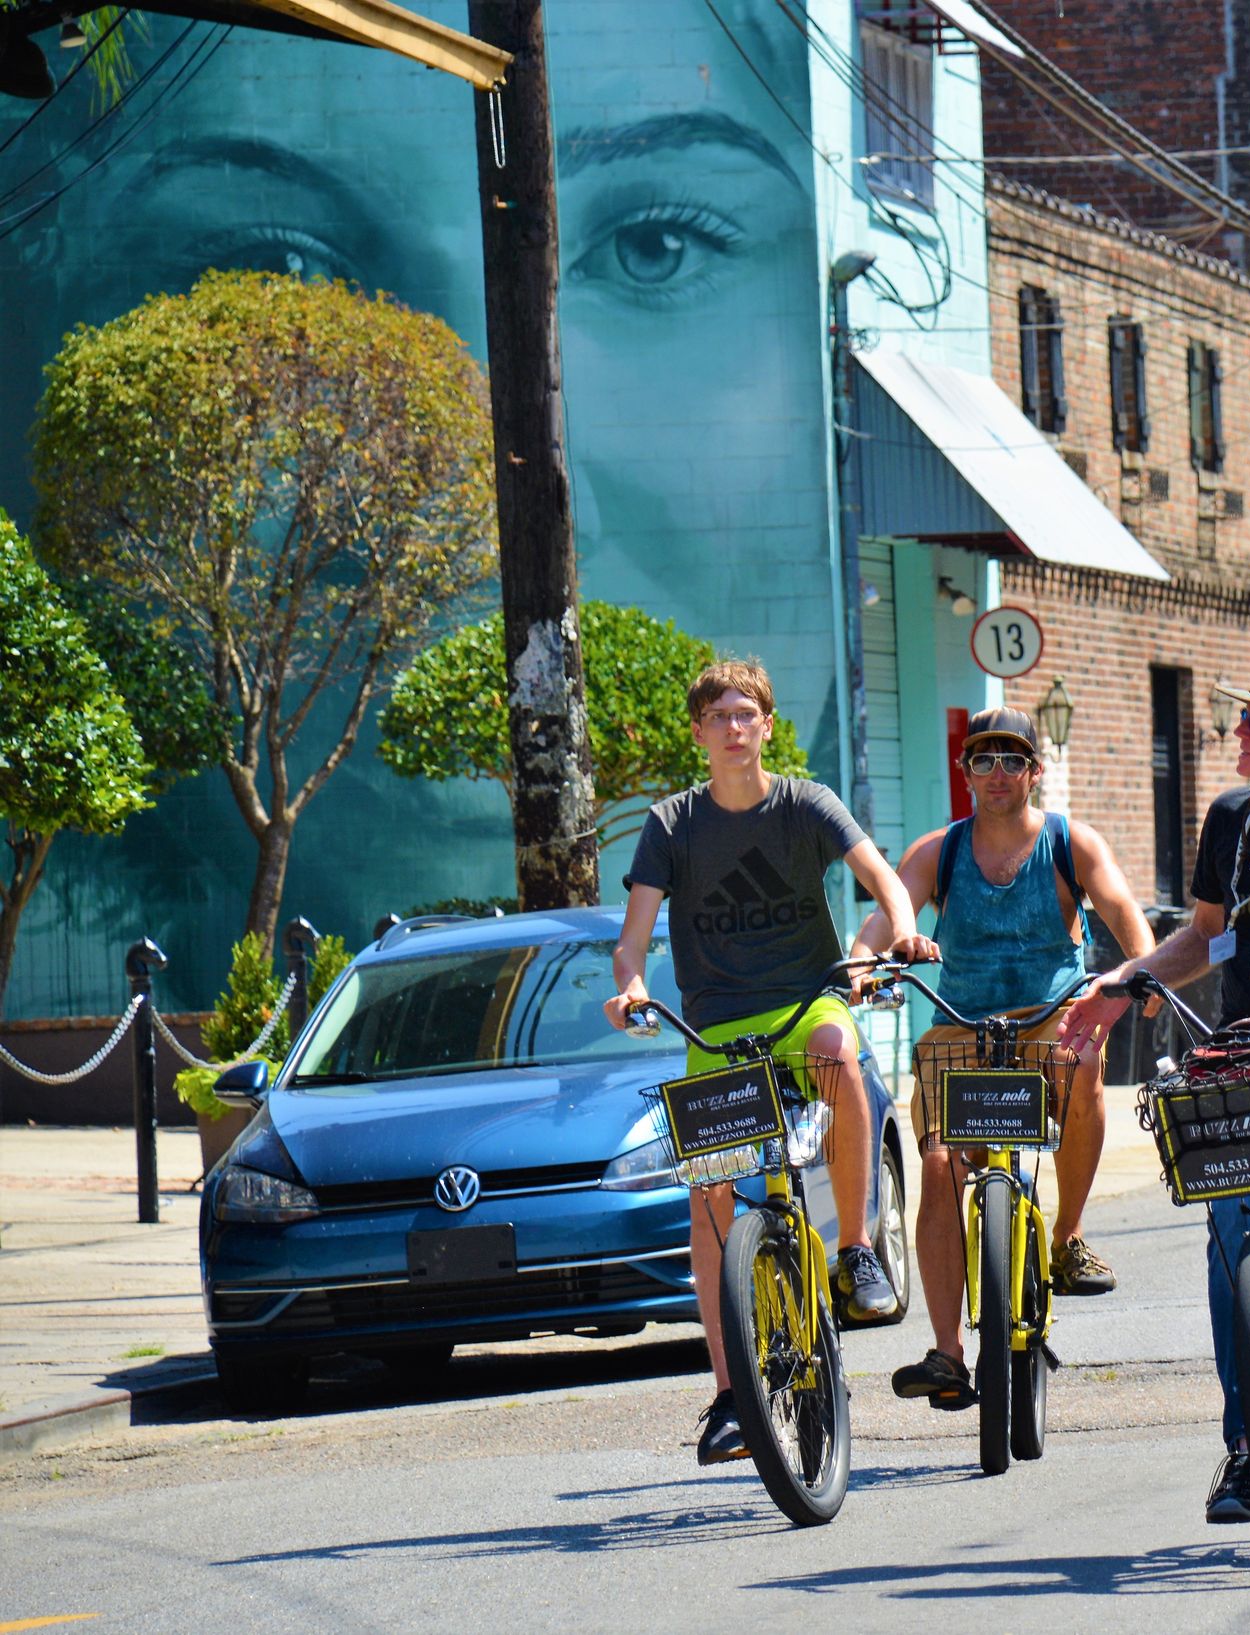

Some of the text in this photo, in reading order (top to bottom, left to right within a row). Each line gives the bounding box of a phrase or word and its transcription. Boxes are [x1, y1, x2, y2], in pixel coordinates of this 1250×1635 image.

[990, 623, 1024, 662] 13
[692, 896, 819, 935] adidas
[686, 1082, 758, 1111] BUZZ nola
[962, 1088, 1031, 1101] BUZZ nola
[697, 1116, 757, 1138] 504.533.9688
[950, 1128, 1038, 1136] WWW.BUZZNOLA.COM
[966, 1119, 1022, 1128] 504.533.9688
[1190, 1119, 1240, 1137] BUZZ
[683, 1122, 775, 1150] WWW.BUZZNOLA.COM
